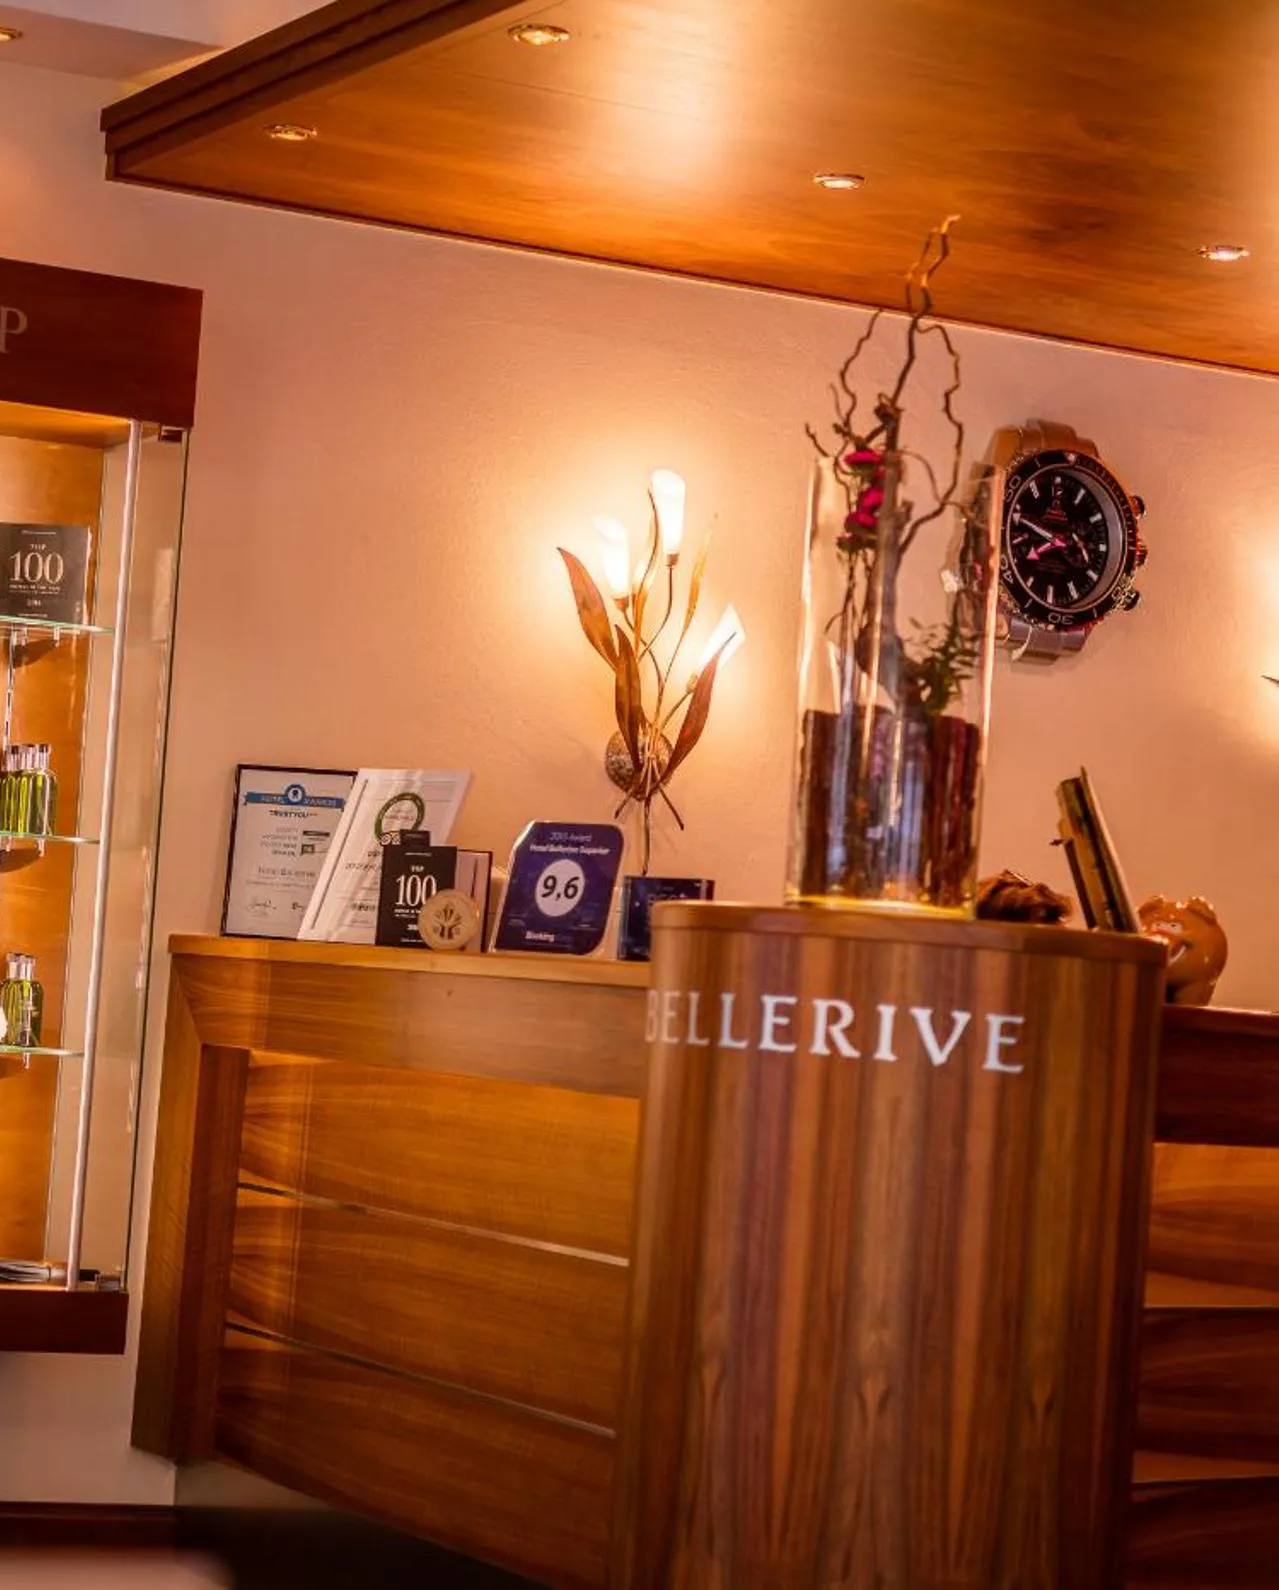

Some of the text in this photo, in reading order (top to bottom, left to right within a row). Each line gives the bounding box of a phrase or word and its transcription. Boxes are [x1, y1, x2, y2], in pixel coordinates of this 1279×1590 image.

[8, 551, 65, 585] 100
[395, 874, 437, 908] 100
[541, 875, 581, 901] 9,6
[645, 989, 1027, 1074] BELLERIVE
